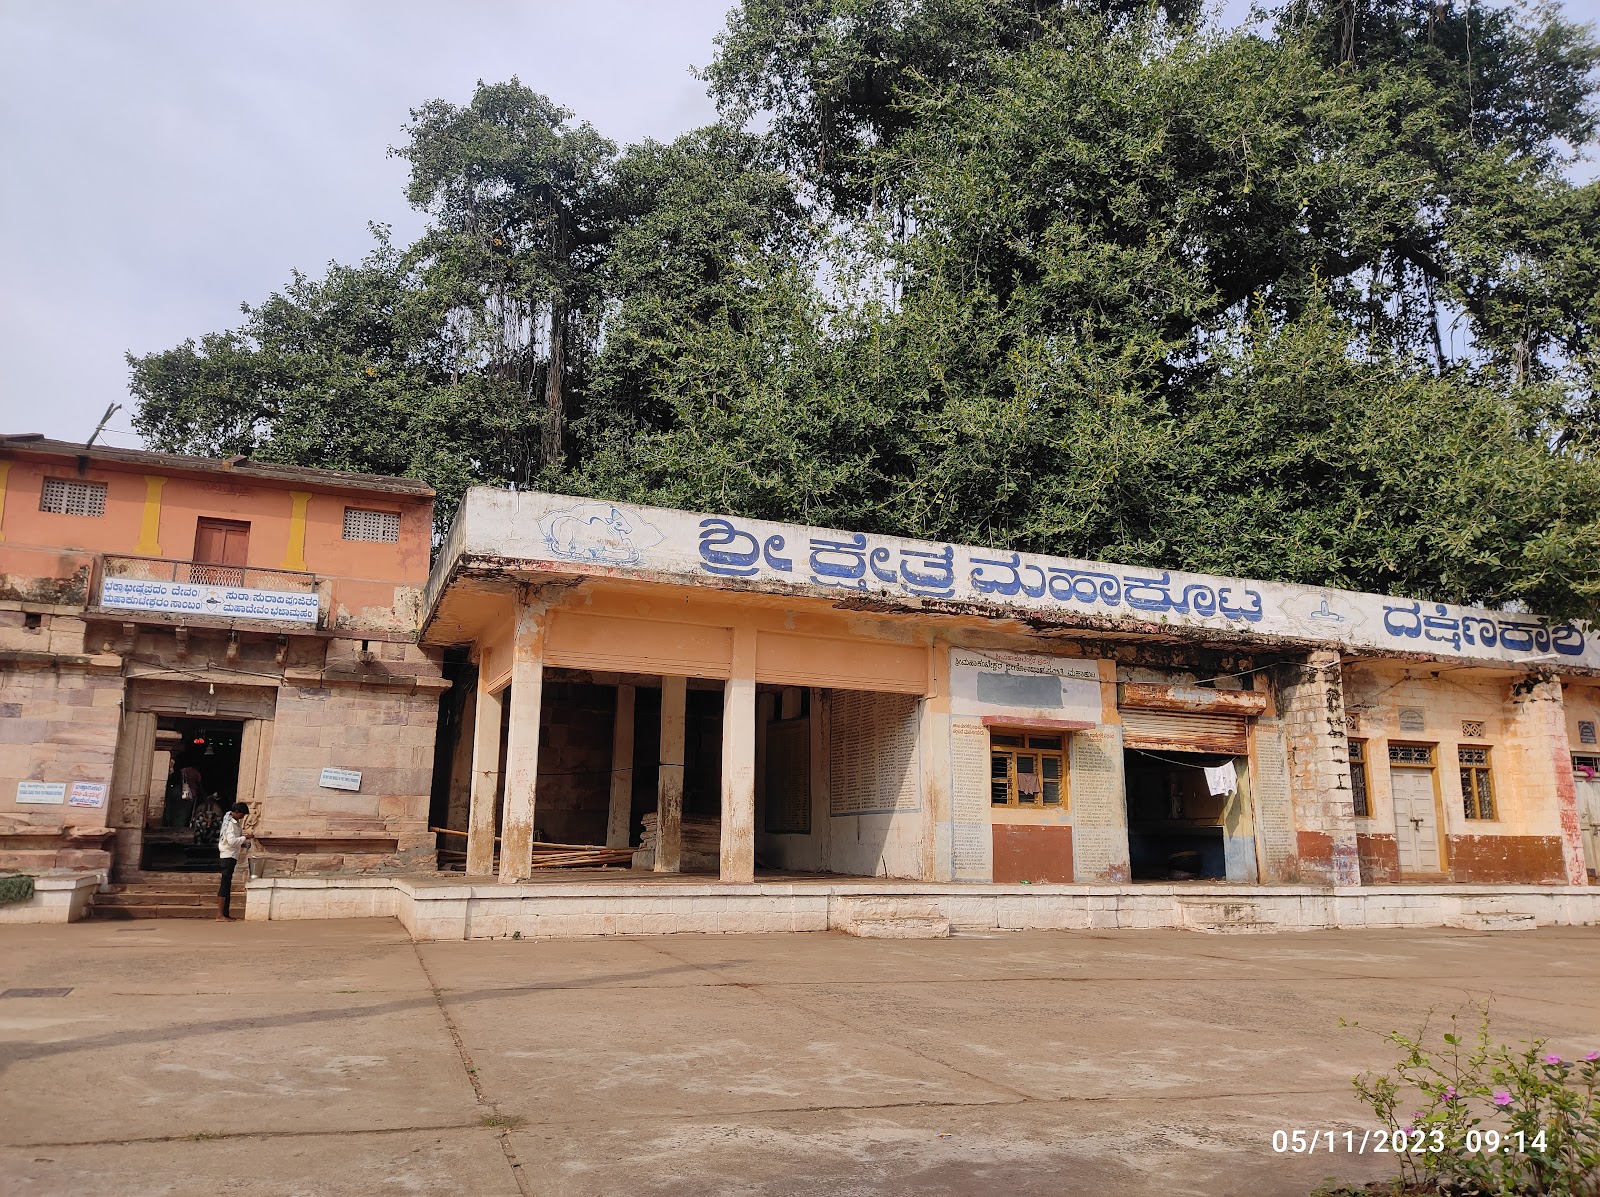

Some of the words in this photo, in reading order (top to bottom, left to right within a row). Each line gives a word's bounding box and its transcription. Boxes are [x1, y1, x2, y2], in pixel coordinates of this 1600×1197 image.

[698, 518, 793, 577] ಶ್ರೀ
[809, 532, 956, 600] ಕ್ಷೇತ್ರ
[969, 552, 1264, 622] ಮಹಾಕೂಟ
